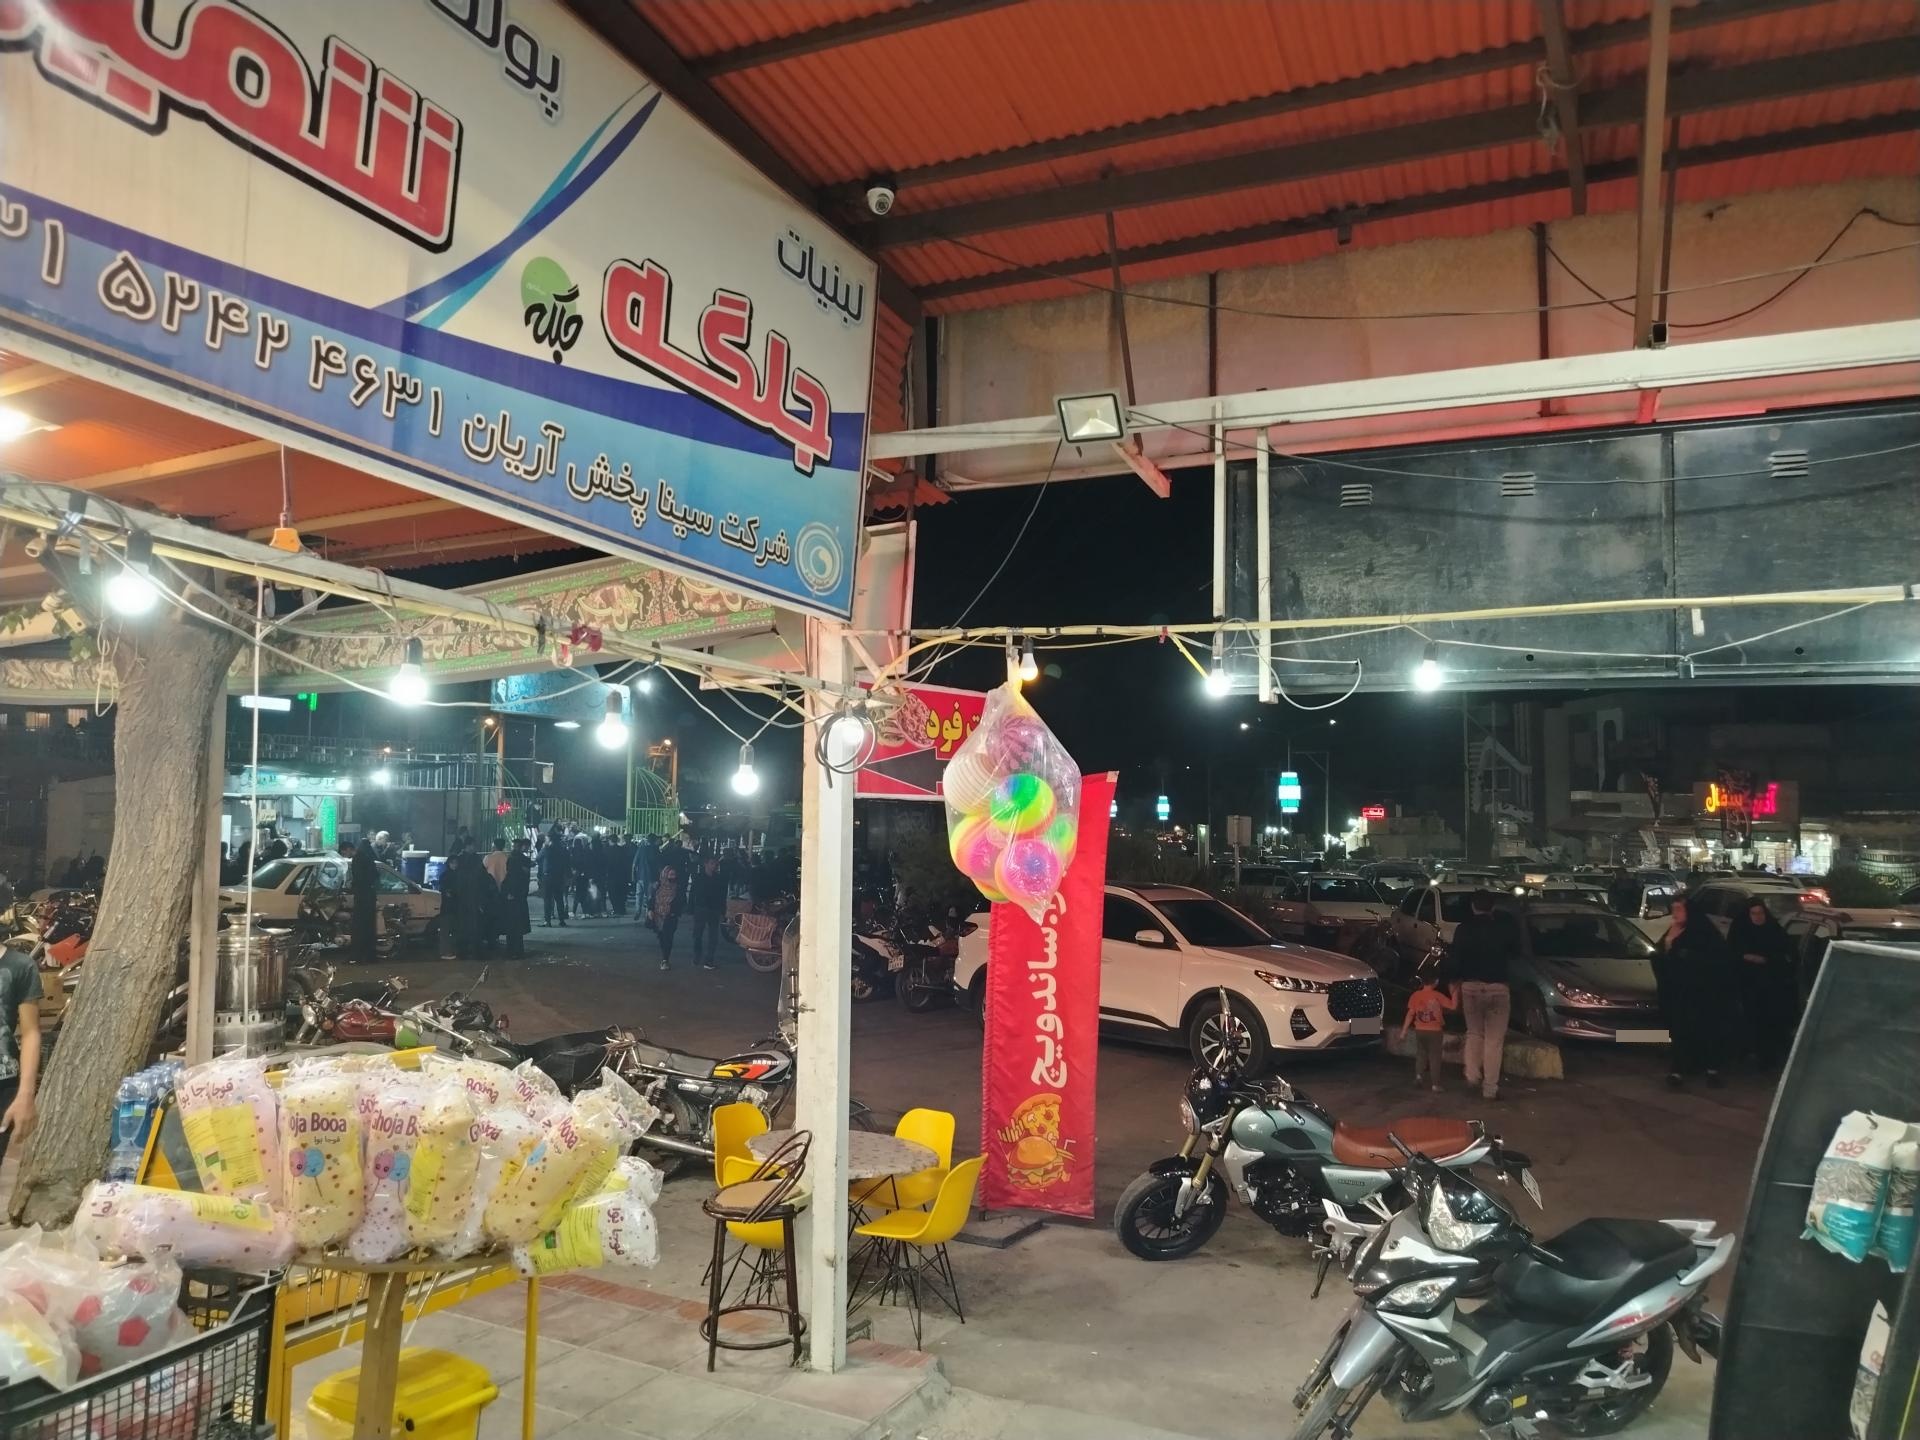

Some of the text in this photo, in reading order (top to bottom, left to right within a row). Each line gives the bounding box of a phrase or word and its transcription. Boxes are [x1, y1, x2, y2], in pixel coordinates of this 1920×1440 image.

[100, 250, 288, 368] ۵۲۴۲
[310, 336, 443, 436] ۴۶۳۱
[777, 229, 863, 324] لبنیات
[601, 258, 832, 478] جلگه
[462, 410, 791, 566] شرکت سینا پخش آریان
[1027, 925, 1068, 1089] ساندویچ
[289, 1112, 347, 1138] oja Booa
